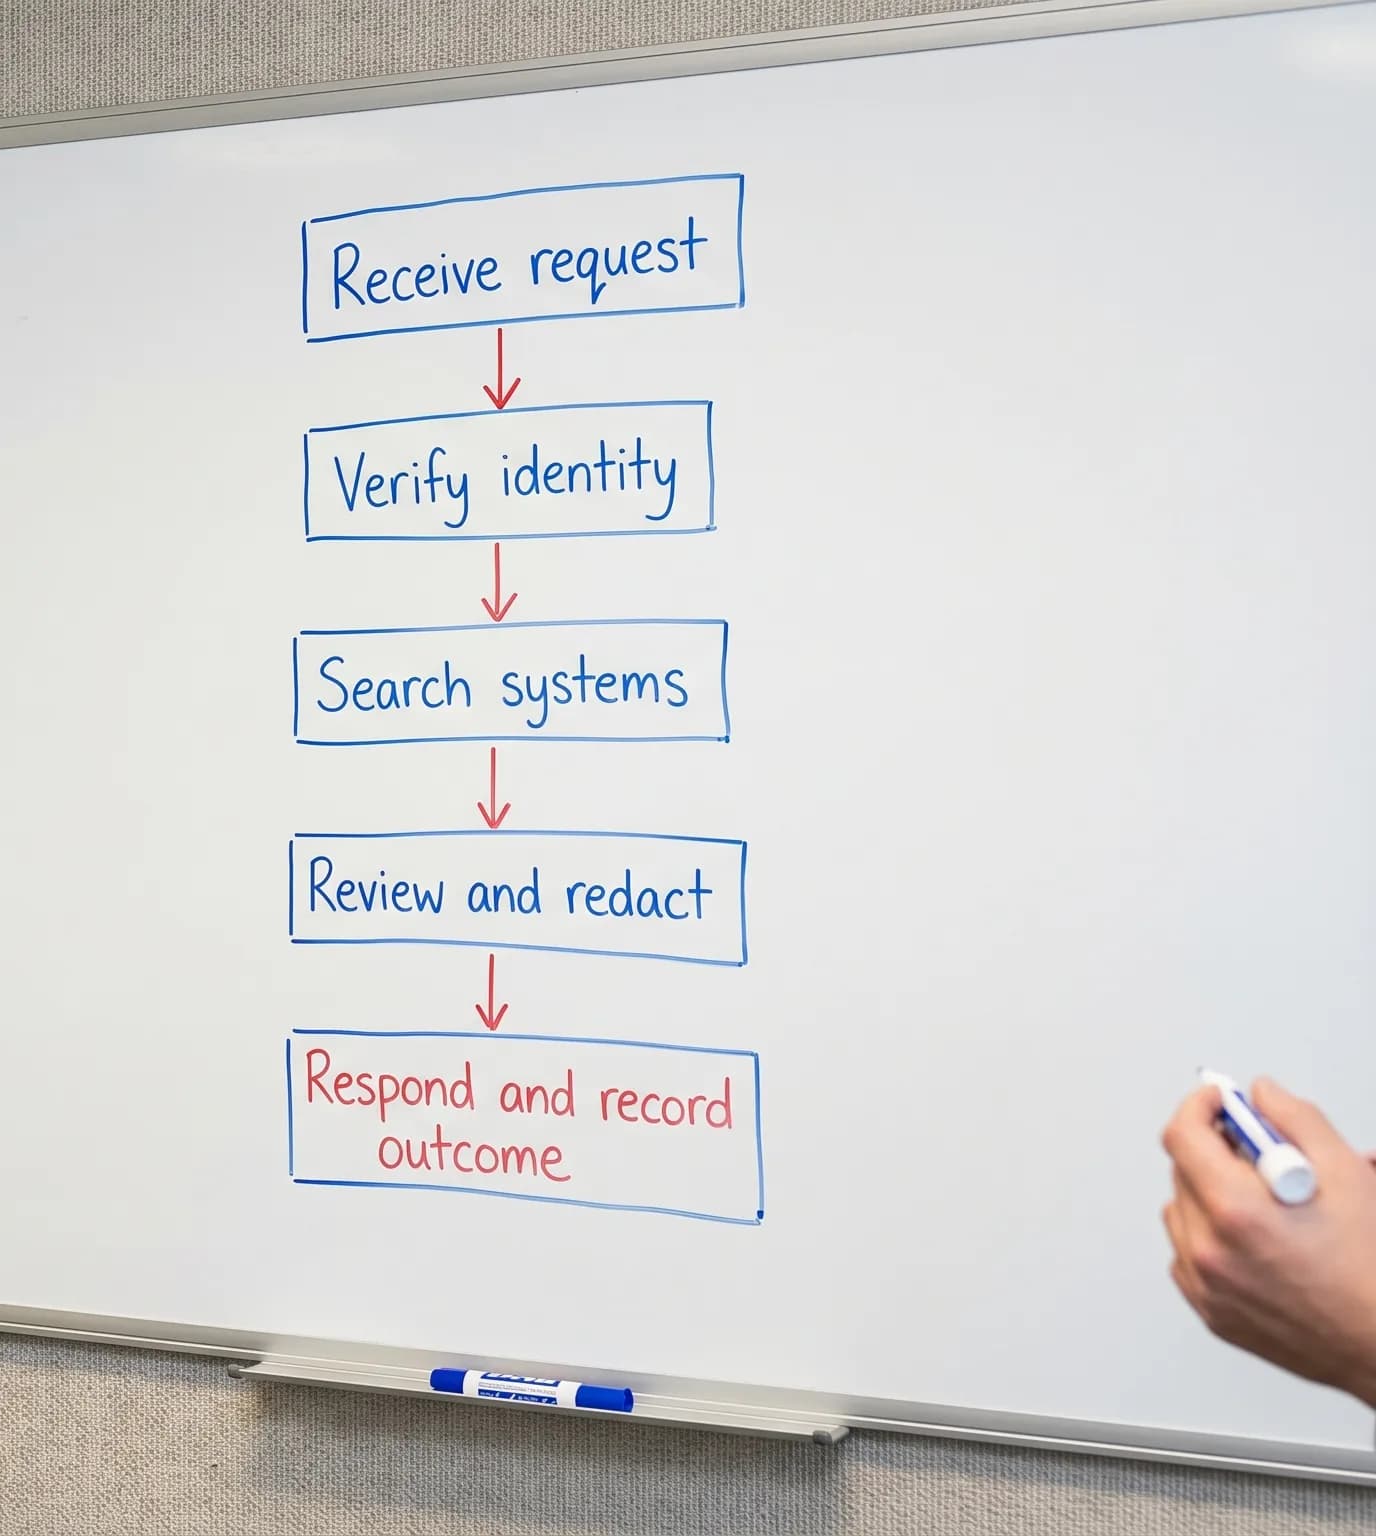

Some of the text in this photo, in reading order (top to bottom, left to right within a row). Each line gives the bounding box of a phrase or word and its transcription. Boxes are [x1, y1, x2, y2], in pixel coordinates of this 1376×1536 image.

[333, 215, 709, 310] Receive request
[333, 436, 677, 529] Verify identity
[317, 654, 689, 730] Search systems
[309, 855, 714, 921] Review and redact
[305, 1047, 733, 1129] Respond and record
[378, 1124, 571, 1183] outcome
